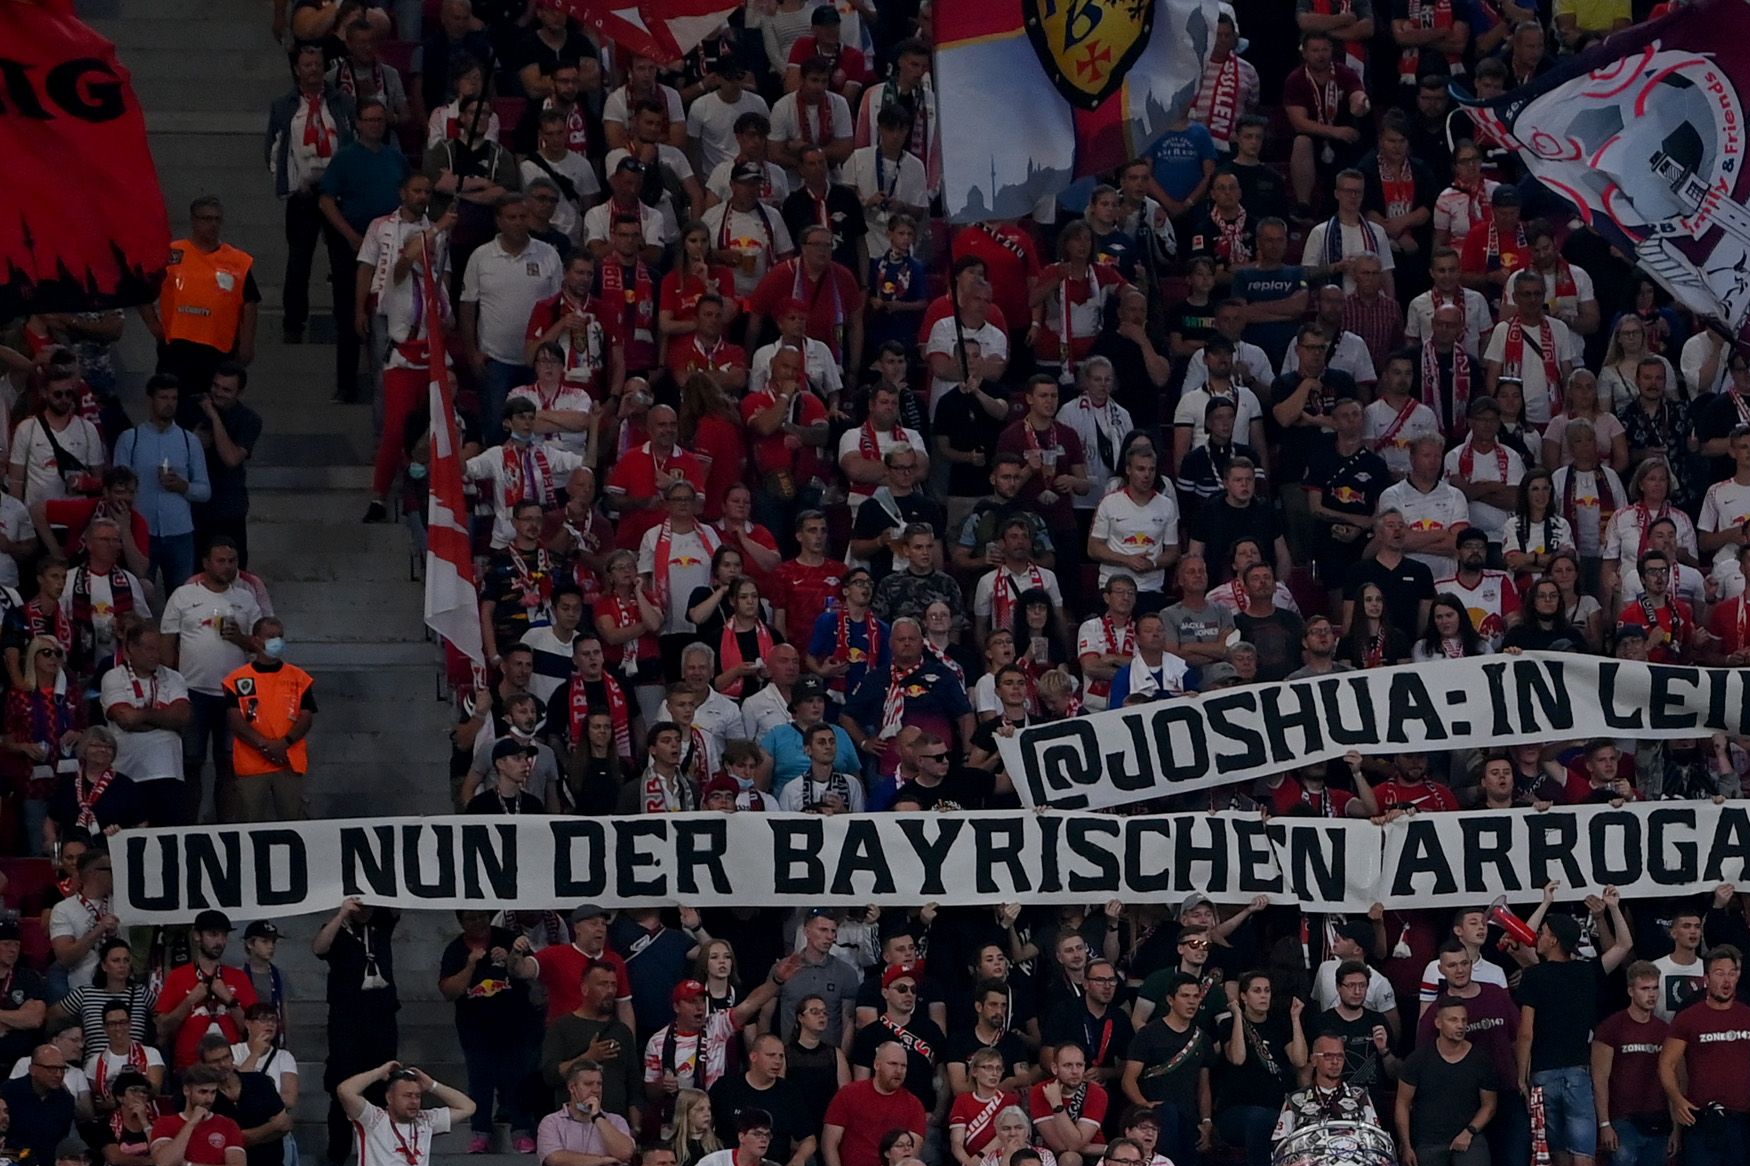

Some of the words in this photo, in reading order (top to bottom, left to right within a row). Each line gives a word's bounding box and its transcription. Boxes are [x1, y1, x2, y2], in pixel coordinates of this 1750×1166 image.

[1705, 70, 1739, 155] Friends
[1247, 279, 1293, 293] replay
[126, 829, 307, 911] UND
[342, 824, 517, 900] NUN
[552, 817, 732, 898] DER
[769, 815, 1346, 903] BAYRISCHEN
